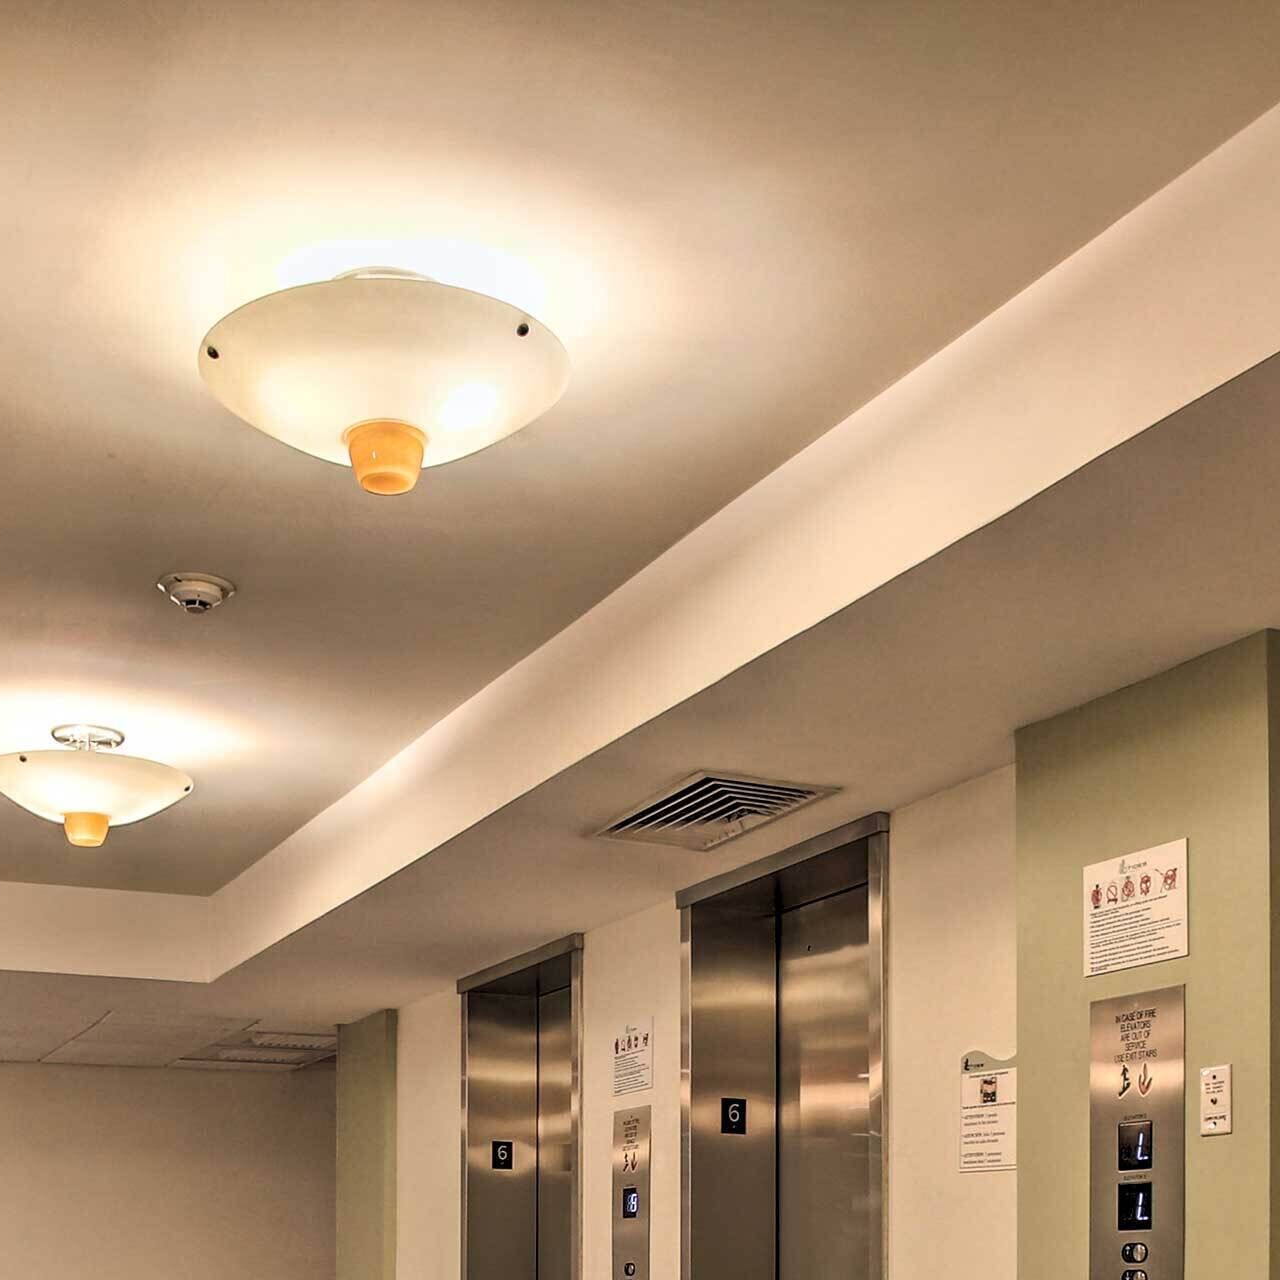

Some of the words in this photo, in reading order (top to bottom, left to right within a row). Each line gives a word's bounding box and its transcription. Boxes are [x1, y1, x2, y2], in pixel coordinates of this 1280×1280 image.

[1121, 1012, 1135, 1022] CASE
[1136, 1010, 1144, 1020] OF
[1144, 1008, 1157, 1018] FIRE
[1120, 1020, 1152, 1032] ELEVATORS
[1121, 1032, 1130, 1042] ARE
[1131, 1031, 1142, 1041] OUT
[1143, 1029, 1151, 1039] OF
[1125, 1040, 1147, 1051] SERVICE
[1125, 1051, 1137, 1062] EXIT
[1137, 1048, 1158, 1060] STAIRS
[728, 1103, 740, 1123] 6
[497, 1145, 507, 1161] 6
